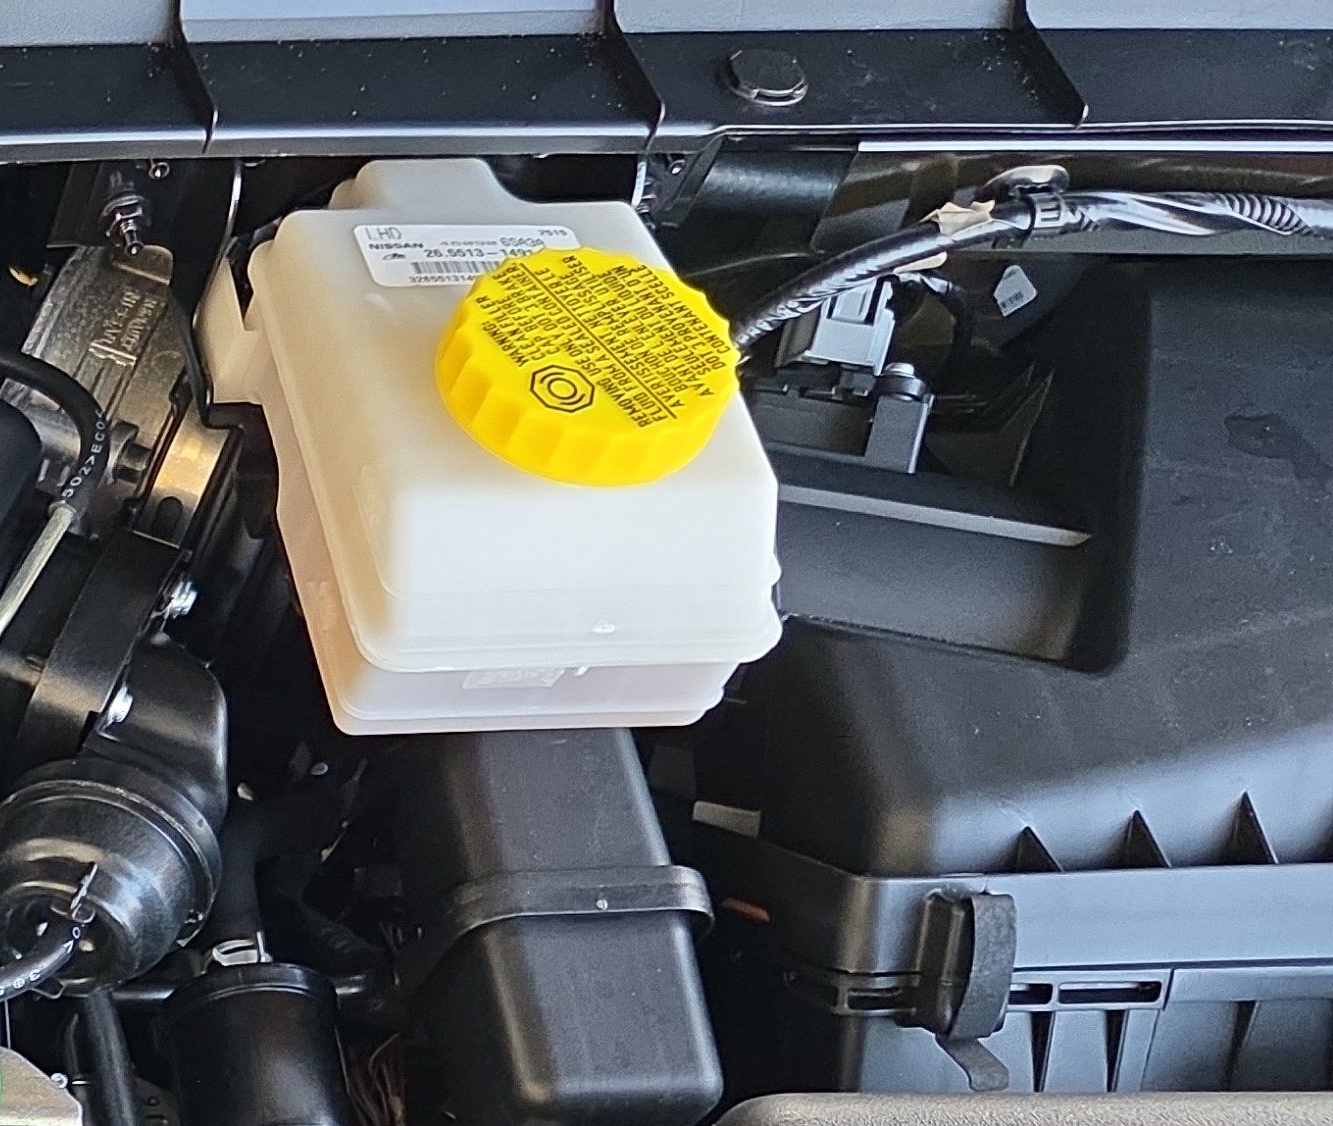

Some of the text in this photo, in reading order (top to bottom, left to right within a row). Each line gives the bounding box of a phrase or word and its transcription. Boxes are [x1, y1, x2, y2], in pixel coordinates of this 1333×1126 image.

[365, 227, 402, 240] LHD
[491, 270, 531, 304] BRAKE
[534, 266, 556, 281] LE
[561, 254, 610, 296] UTILISER
[531, 311, 558, 332] DOT
[547, 280, 603, 330] NETTOYER
[596, 270, 711, 376] SEULEMENT DU LIQUIDE
[633, 286, 698, 343] PROVENANT
[474, 294, 546, 361] CLEAN FILLER
[479, 320, 529, 365] WARNING:
[495, 295, 561, 355] CAP BEFORE
[550, 330, 583, 358] ONLY
[555, 314, 600, 354] SEALED
[558, 271, 689, 393] BOUCHON DE REMPLISSAGE
[667, 298, 731, 354] CONTENANT
[574, 355, 602, 376] USE
[656, 347, 678, 363] DE
[699, 349, 726, 370] DOT
[603, 363, 638, 392] FROM
[671, 362, 715, 398] AVANT
[595, 376, 653, 428] REMOVING
[631, 391, 668, 422] FLUID
